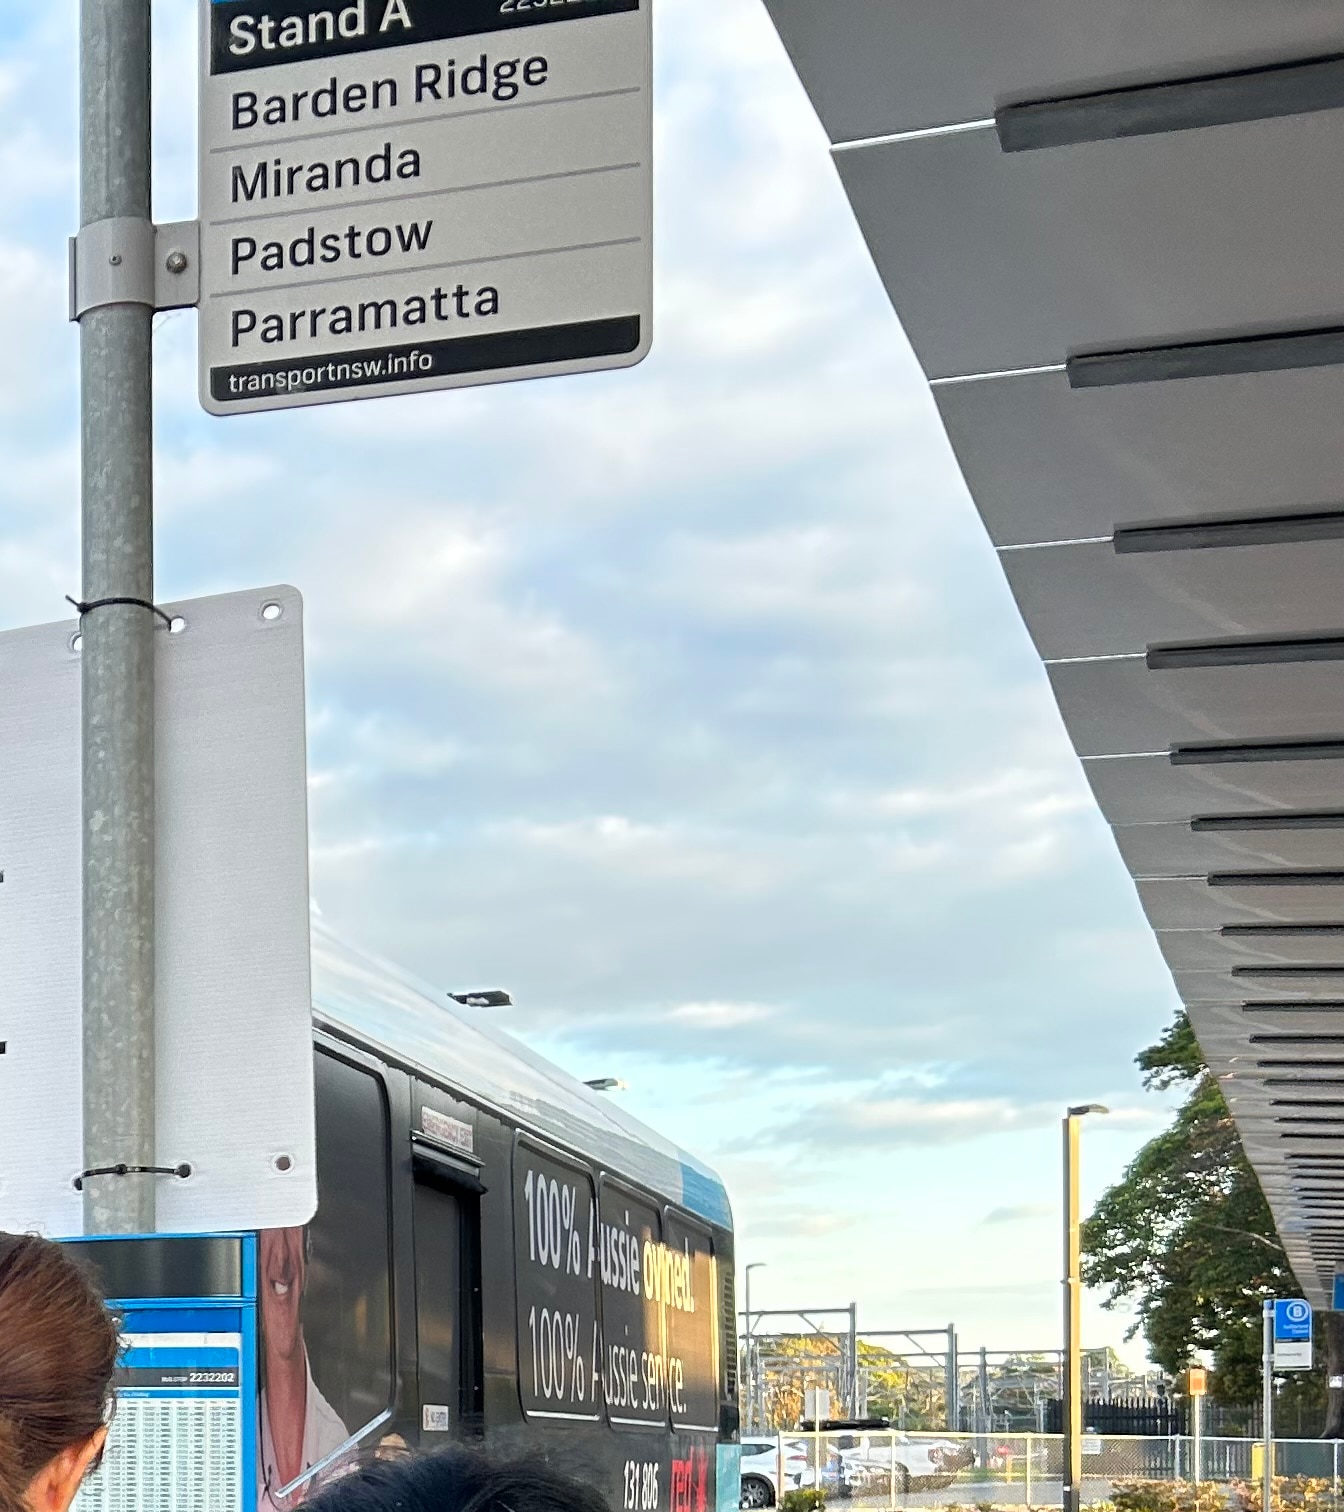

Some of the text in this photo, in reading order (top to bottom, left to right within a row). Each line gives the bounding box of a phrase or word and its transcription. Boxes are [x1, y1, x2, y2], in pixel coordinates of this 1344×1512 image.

[229, 0, 412, 55] Stand A
[232, 54, 549, 130] Barden Ridge
[231, 142, 421, 202] Miranda
[231, 220, 433, 275] Padstow
[231, 283, 500, 347] Parramatta
[229, 350, 432, 393] transportnsw.info
[524, 1170, 581, 1275] 100%
[587, 1197, 640, 1296] Aussie
[528, 1306, 585, 1403] 100%
[591, 1320, 638, 1409] Aussie
[624, 1460, 659, 1510] 131 806
